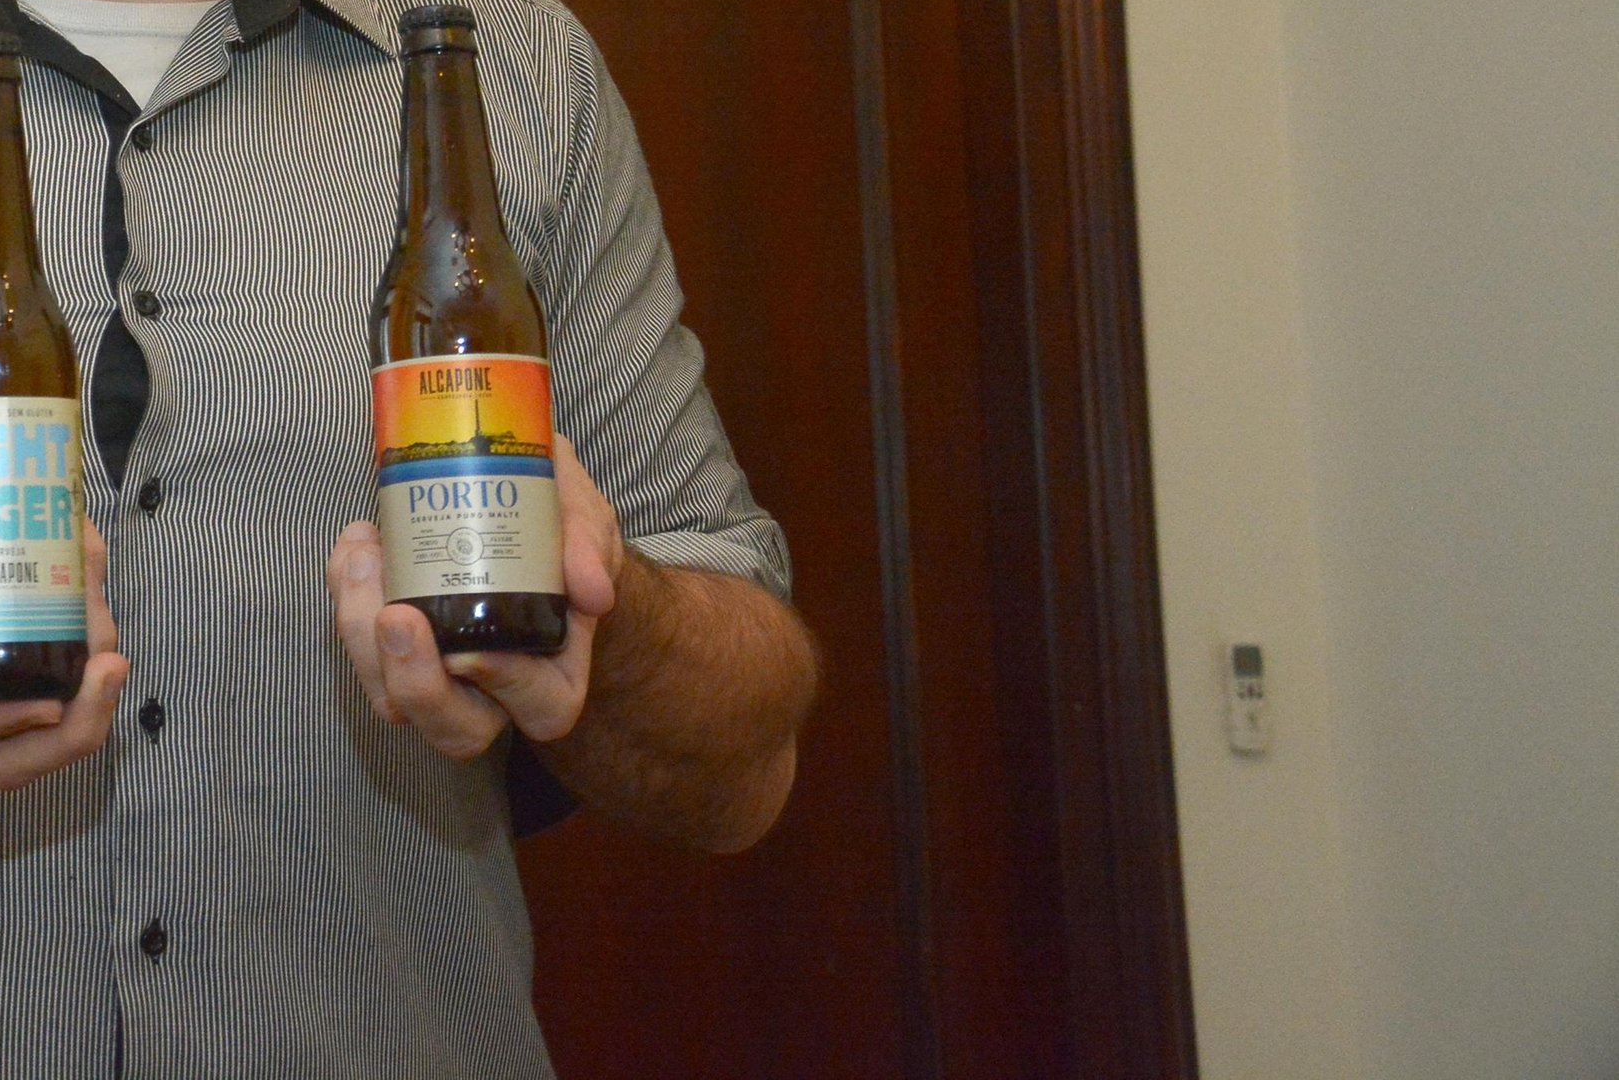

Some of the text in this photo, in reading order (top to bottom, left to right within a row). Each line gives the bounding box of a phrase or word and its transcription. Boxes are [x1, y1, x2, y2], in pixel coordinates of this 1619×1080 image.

[419, 367, 492, 395] ALCAPONE
[409, 479, 518, 513] PORTO
[410, 511, 520, 524] CERVEJA PURO MALTE
[440, 571, 495, 588] 355mL
